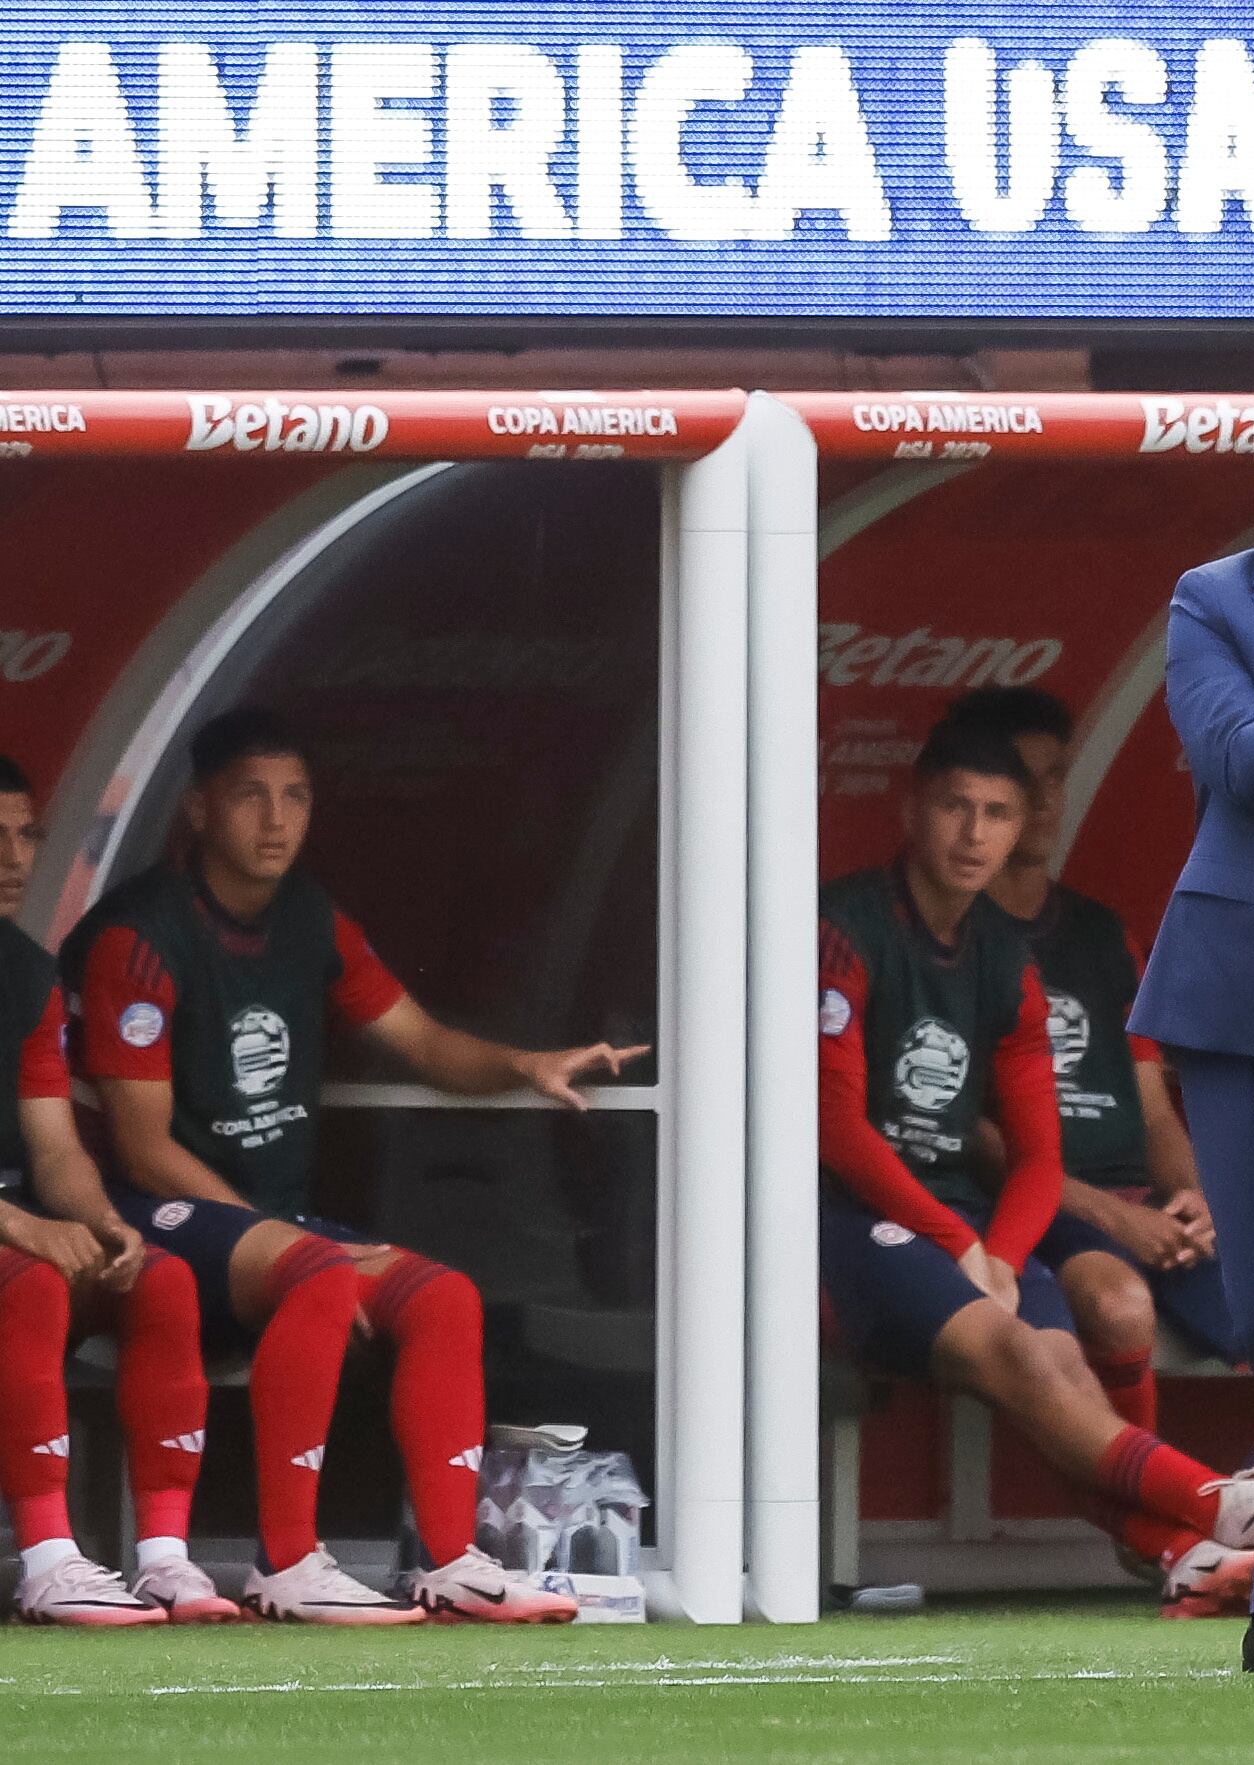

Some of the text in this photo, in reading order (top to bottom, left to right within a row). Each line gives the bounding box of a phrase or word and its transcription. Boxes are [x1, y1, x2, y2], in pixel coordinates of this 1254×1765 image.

[6, 41, 892, 240] AMERICA
[186, 395, 389, 452] Betano
[487, 407, 678, 435] COPA AMERICA
[852, 405, 1043, 433] COPA AMERICA
